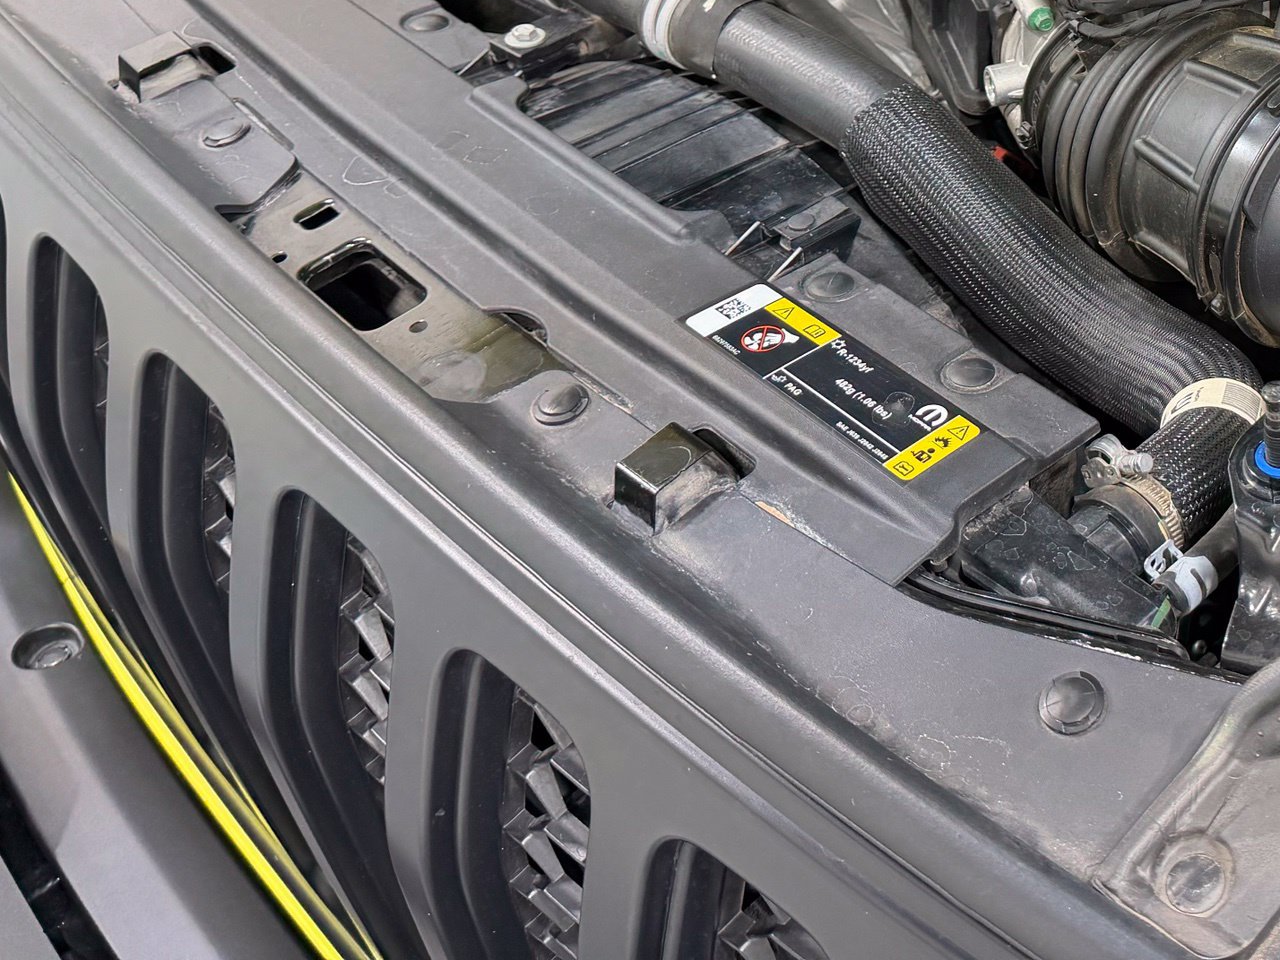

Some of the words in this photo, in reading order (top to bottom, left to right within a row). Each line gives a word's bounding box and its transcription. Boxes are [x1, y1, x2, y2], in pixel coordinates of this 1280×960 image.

[837, 346, 874, 374] R-1234yf
[784, 380, 803, 397] PAG
[834, 377, 856, 396] 482g
[852, 389, 876, 408] (1.06
[872, 403, 893, 422] lbs)
